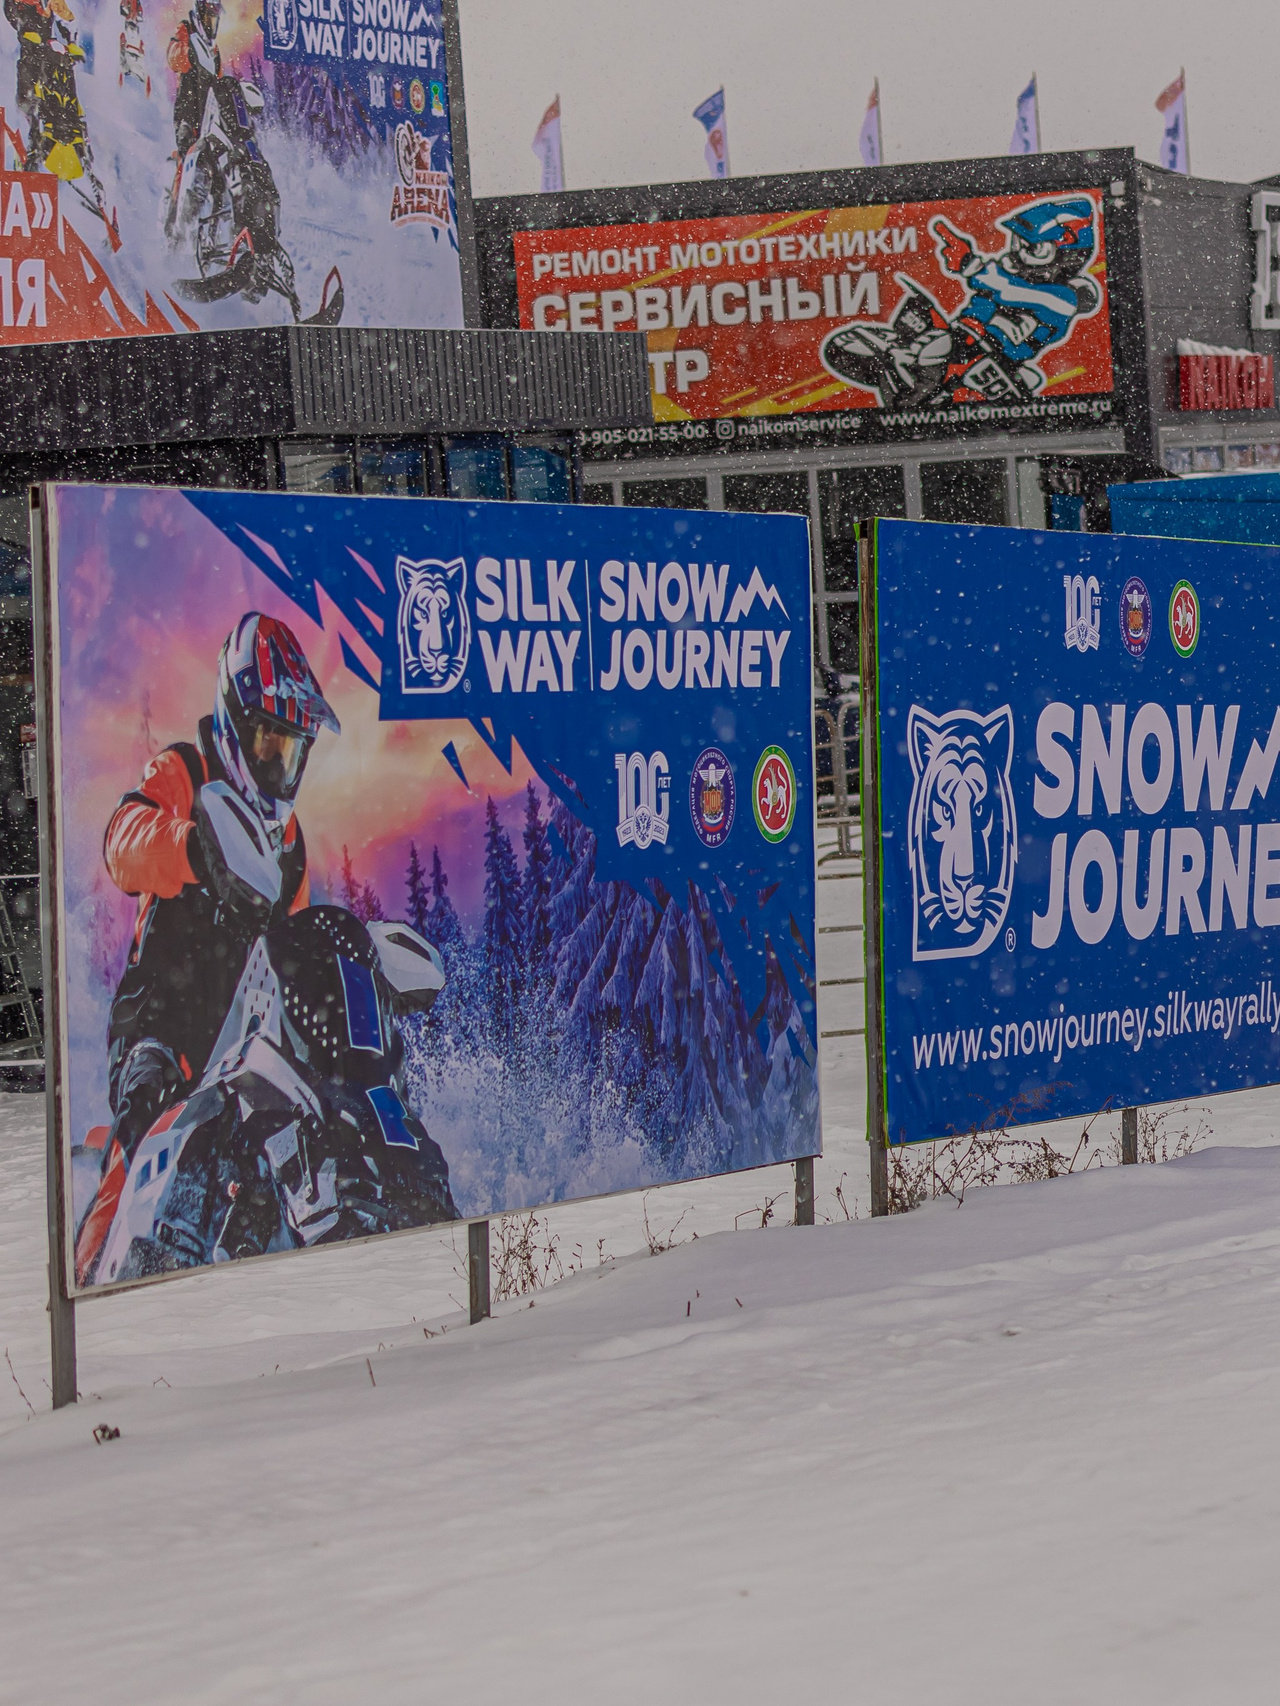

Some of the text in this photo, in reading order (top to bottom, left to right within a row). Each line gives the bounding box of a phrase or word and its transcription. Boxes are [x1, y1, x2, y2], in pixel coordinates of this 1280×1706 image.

[300, 20, 441, 69] WAY JOURNEY
[390, 185, 450, 224] ARENA
[532, 227, 918, 279] РЕМОНТ МОТОТЕХНИКИ
[532, 262, 881, 331] СЕРВИСНЫЙ
[738, 416, 862, 436] naikomservice
[880, 400, 1112, 426] www.naikomextreme.ru
[475, 557, 730, 622] SILK SNOW
[478, 628, 791, 693] WAY JOURNEY
[1033, 702, 1241, 818] SNOW
[706, 833, 722, 843] MFR
